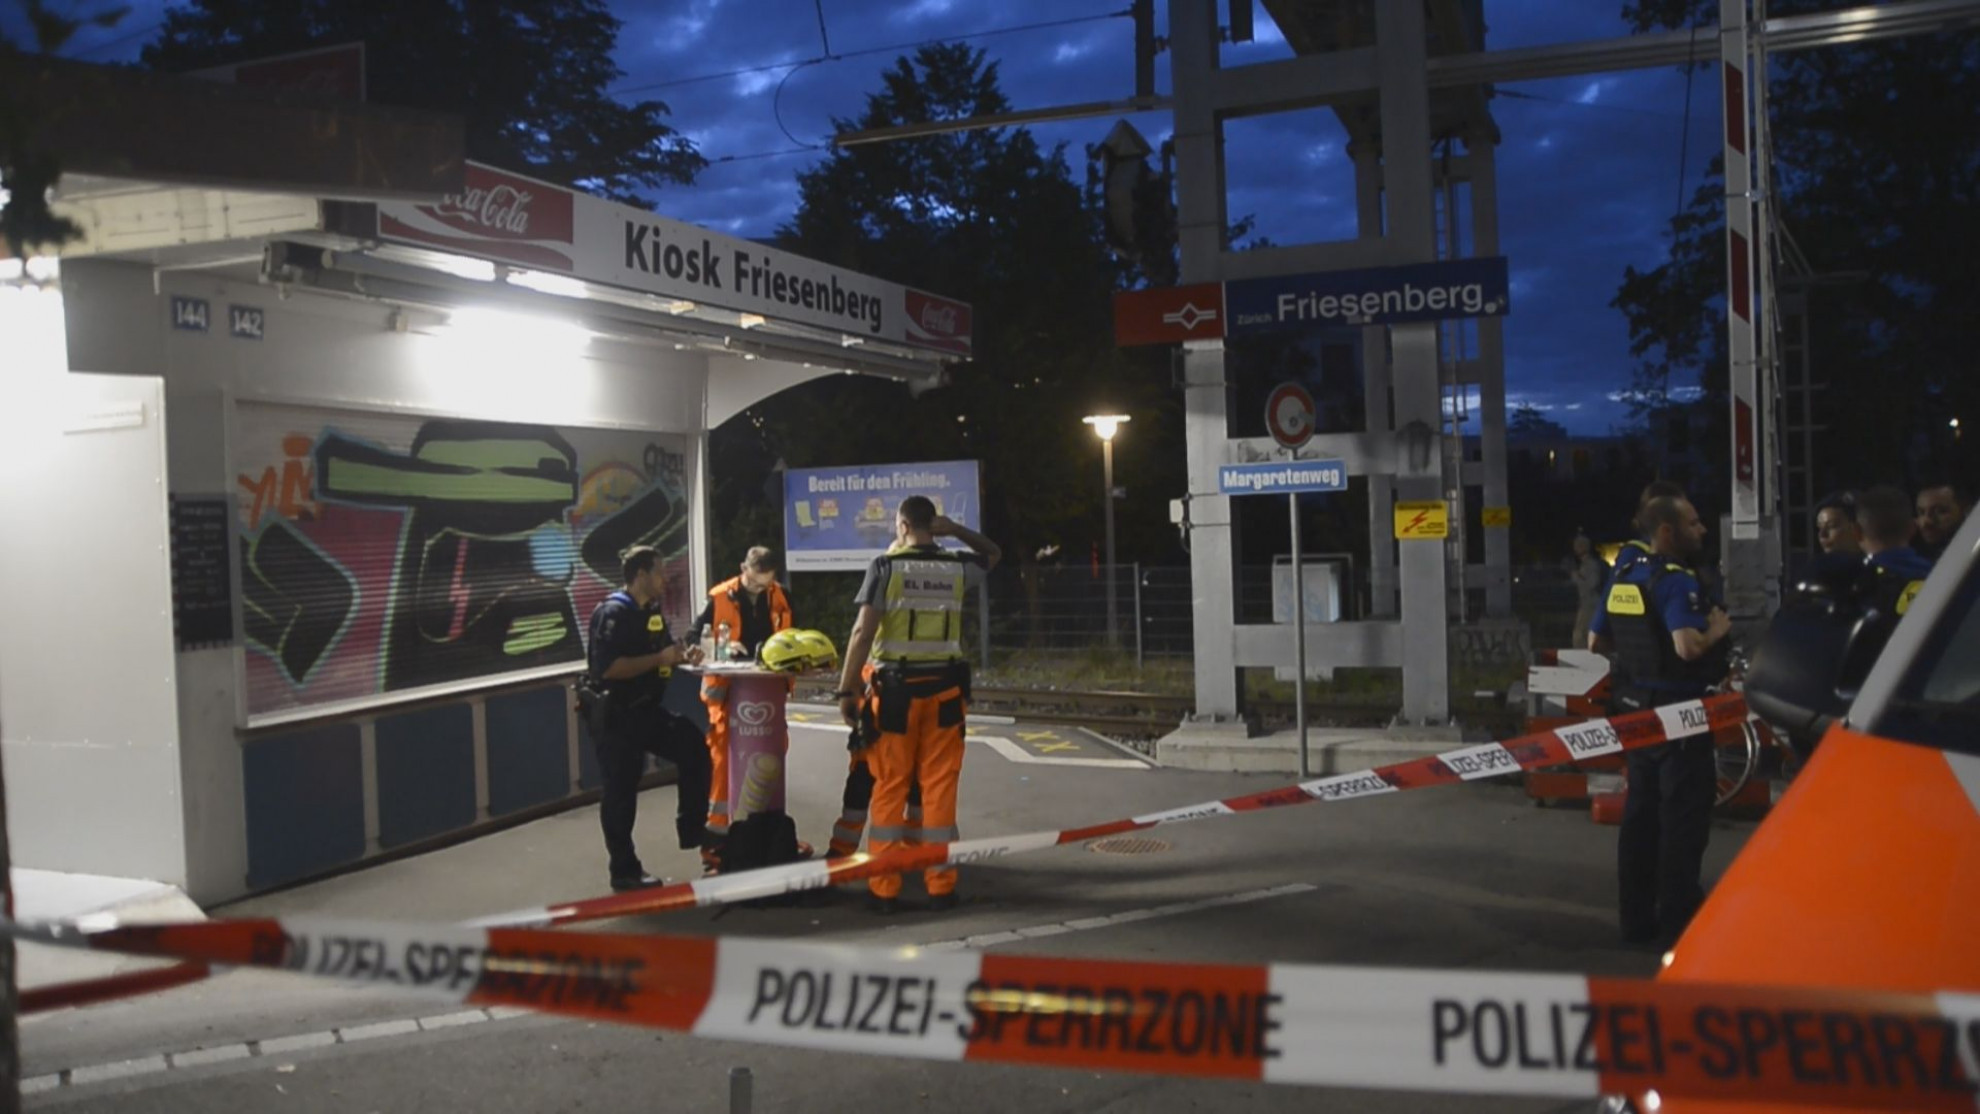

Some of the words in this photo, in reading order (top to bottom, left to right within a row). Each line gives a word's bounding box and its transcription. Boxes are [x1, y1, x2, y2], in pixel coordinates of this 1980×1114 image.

[625, 220, 722, 288] Kiosk
[734, 249, 882, 333] Friesenberg
[177, 301, 206, 328] 144
[1277, 283, 1482, 322] Friesenberg
[234, 310, 261, 336] 142
[808, 475, 845, 493] Bereit
[847, 474, 866, 491] für
[867, 473, 891, 490] den
[893, 471, 951, 489] Frühling.
[1222, 468, 1341, 491] Margaretenweg
[923, 579, 953, 591] Bahn
[1612, 594, 1639, 604] POLIZEI
[747, 967, 1285, 1059] POLIZEI-SPERRZONE
